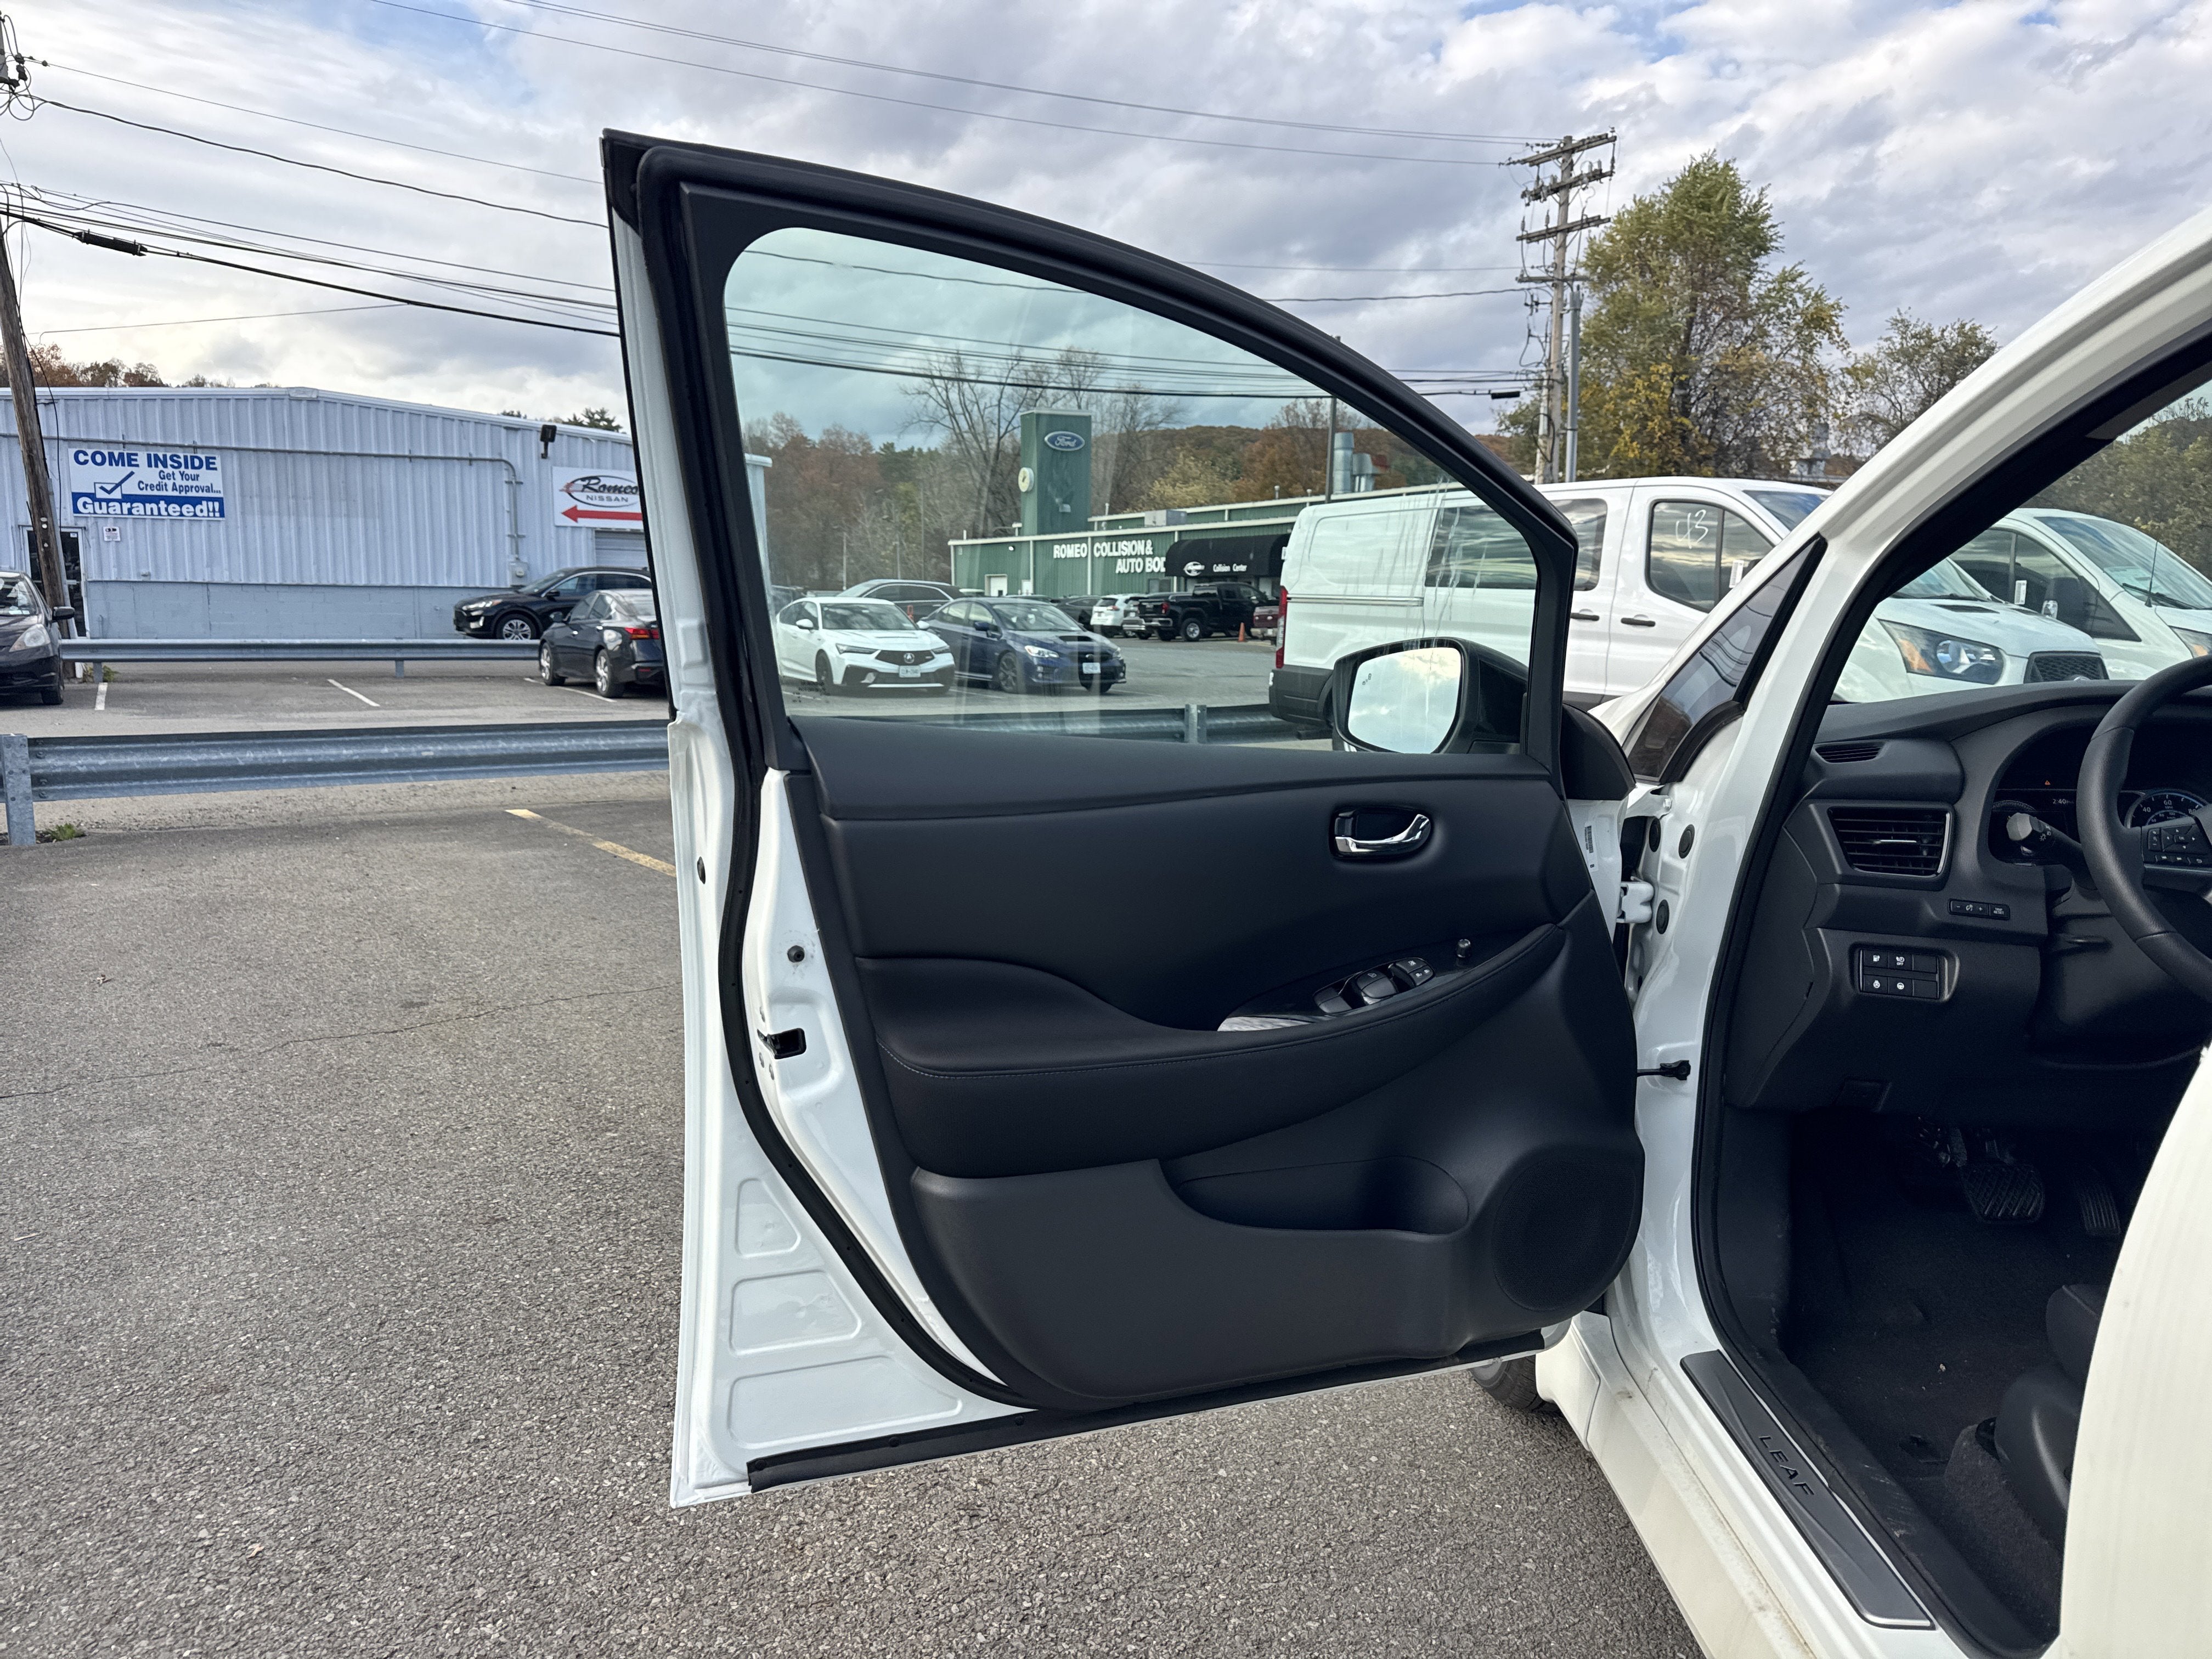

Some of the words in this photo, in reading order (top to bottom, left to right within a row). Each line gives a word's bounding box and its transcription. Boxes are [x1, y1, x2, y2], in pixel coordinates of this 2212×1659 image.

[74, 450, 139, 467] COME
[146, 453, 218, 471] INSIDE
[159, 470, 176, 481] Get
[179, 471, 200, 481] Your
[138, 481, 168, 492] Credit
[172, 482, 221, 494] Approval...
[77, 496, 220, 517] Guaranteed!!
[1053, 543, 1088, 558] ROMEO
[1115, 557, 1143, 574] AUTO
[1758, 1435, 1815, 1495] LEAF
